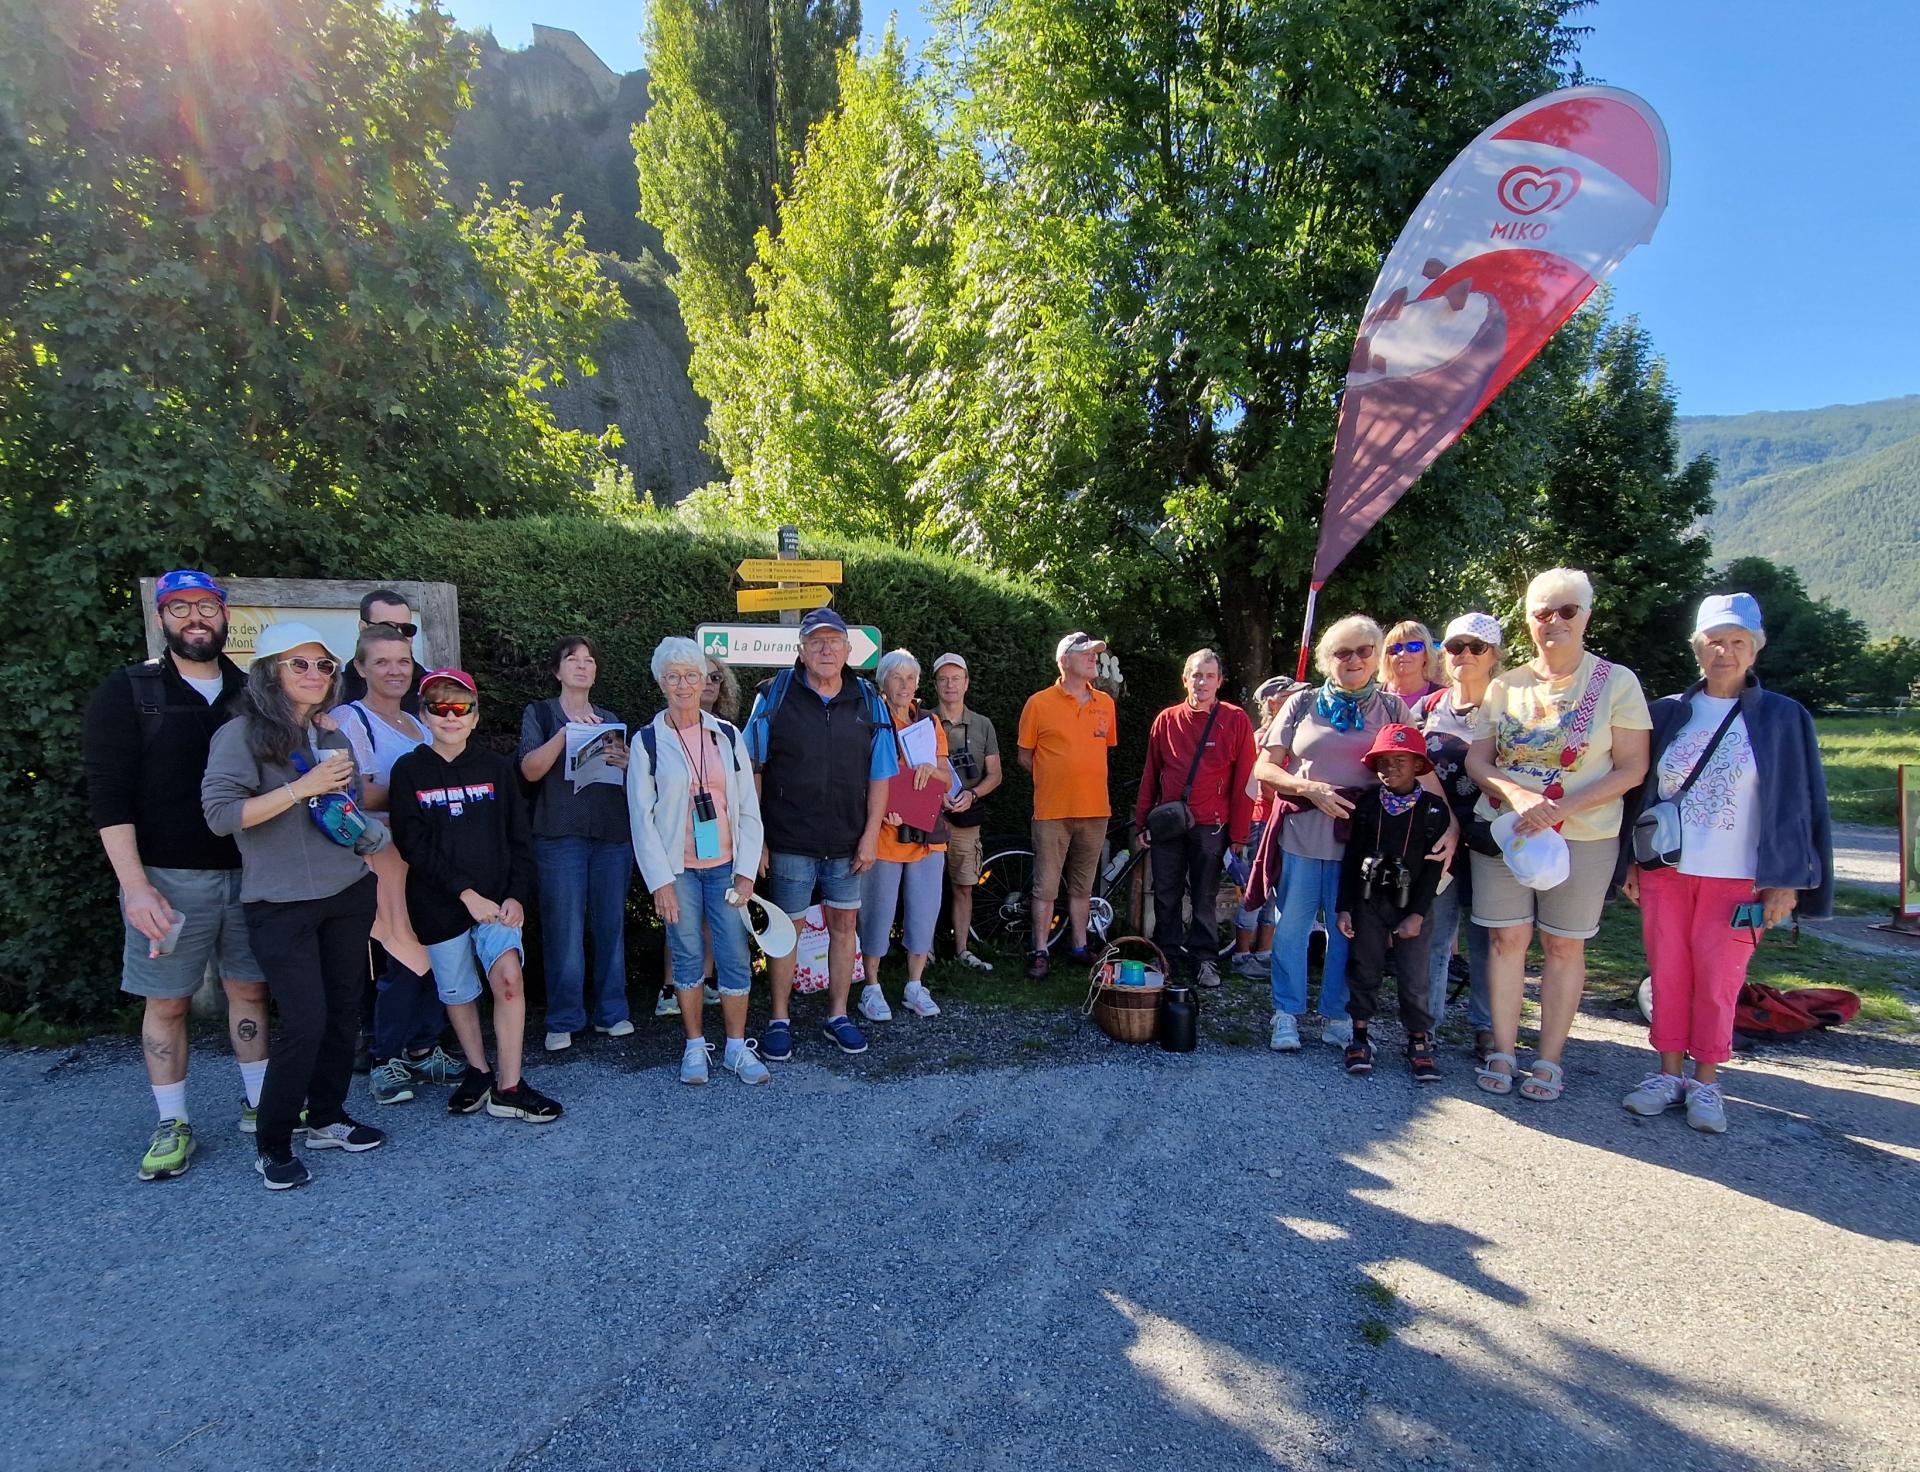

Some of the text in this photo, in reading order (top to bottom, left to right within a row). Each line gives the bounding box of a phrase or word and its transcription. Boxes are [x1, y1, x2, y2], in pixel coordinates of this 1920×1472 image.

[1490, 221, 1548, 241] MIKO
[240, 623, 257, 635] des
[734, 639, 799, 652] La Duranc
